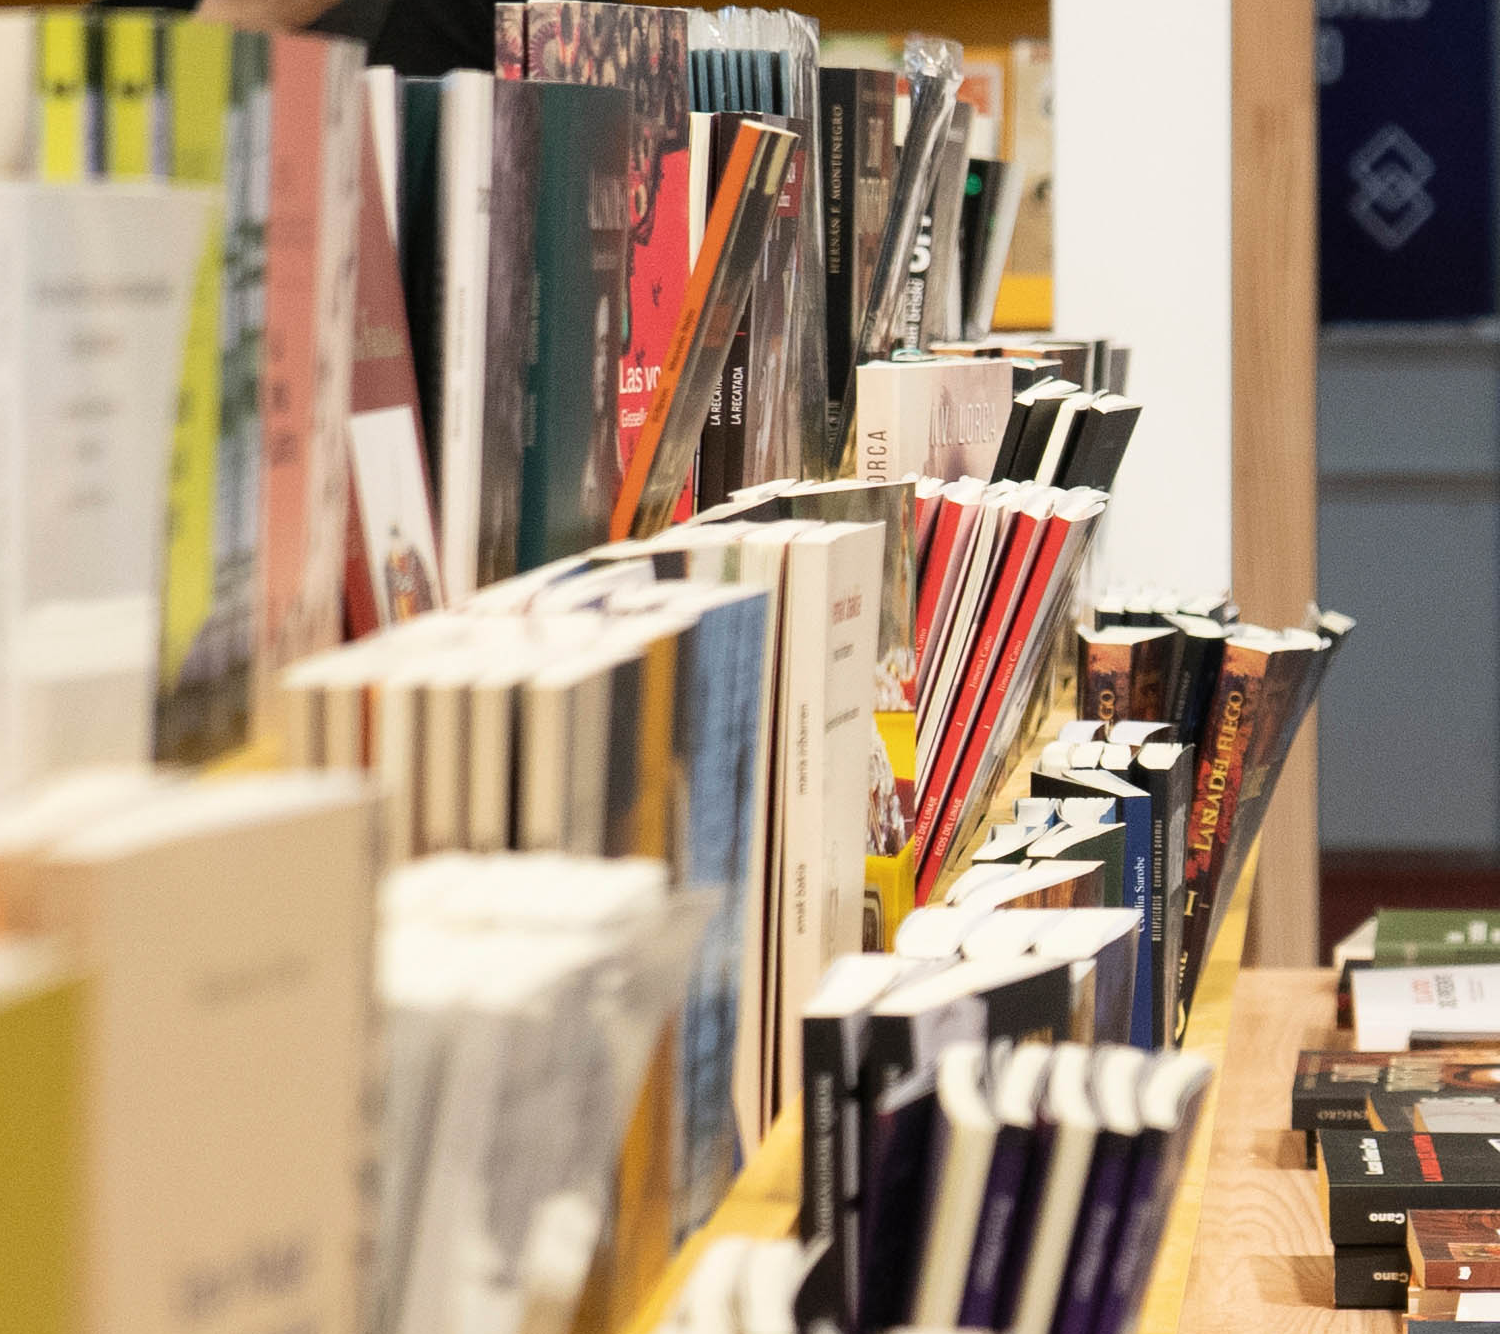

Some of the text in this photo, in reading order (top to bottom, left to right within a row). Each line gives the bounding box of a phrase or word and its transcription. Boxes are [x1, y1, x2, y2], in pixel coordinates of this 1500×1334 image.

[829, 104, 844, 199] MONTENEGRO
[618, 359, 643, 394] Las
[730, 366, 744, 425] LA RECATADA
[917, 820, 929, 836] DEL
[923, 796, 938, 821] LINAJE
[970, 660, 986, 689] Jimena
[980, 634, 994, 658] Cano
[1218, 691, 1244, 751] FUEGO
[934, 639, 1024, 857] ECOS DEL LINAJE Jimena Cano
[1209, 758, 1231, 793] DEL
[1134, 857, 1147, 893] Sarobe
[1368, 1213, 1406, 1225] Cano
[1372, 1272, 1409, 1283] Cano
